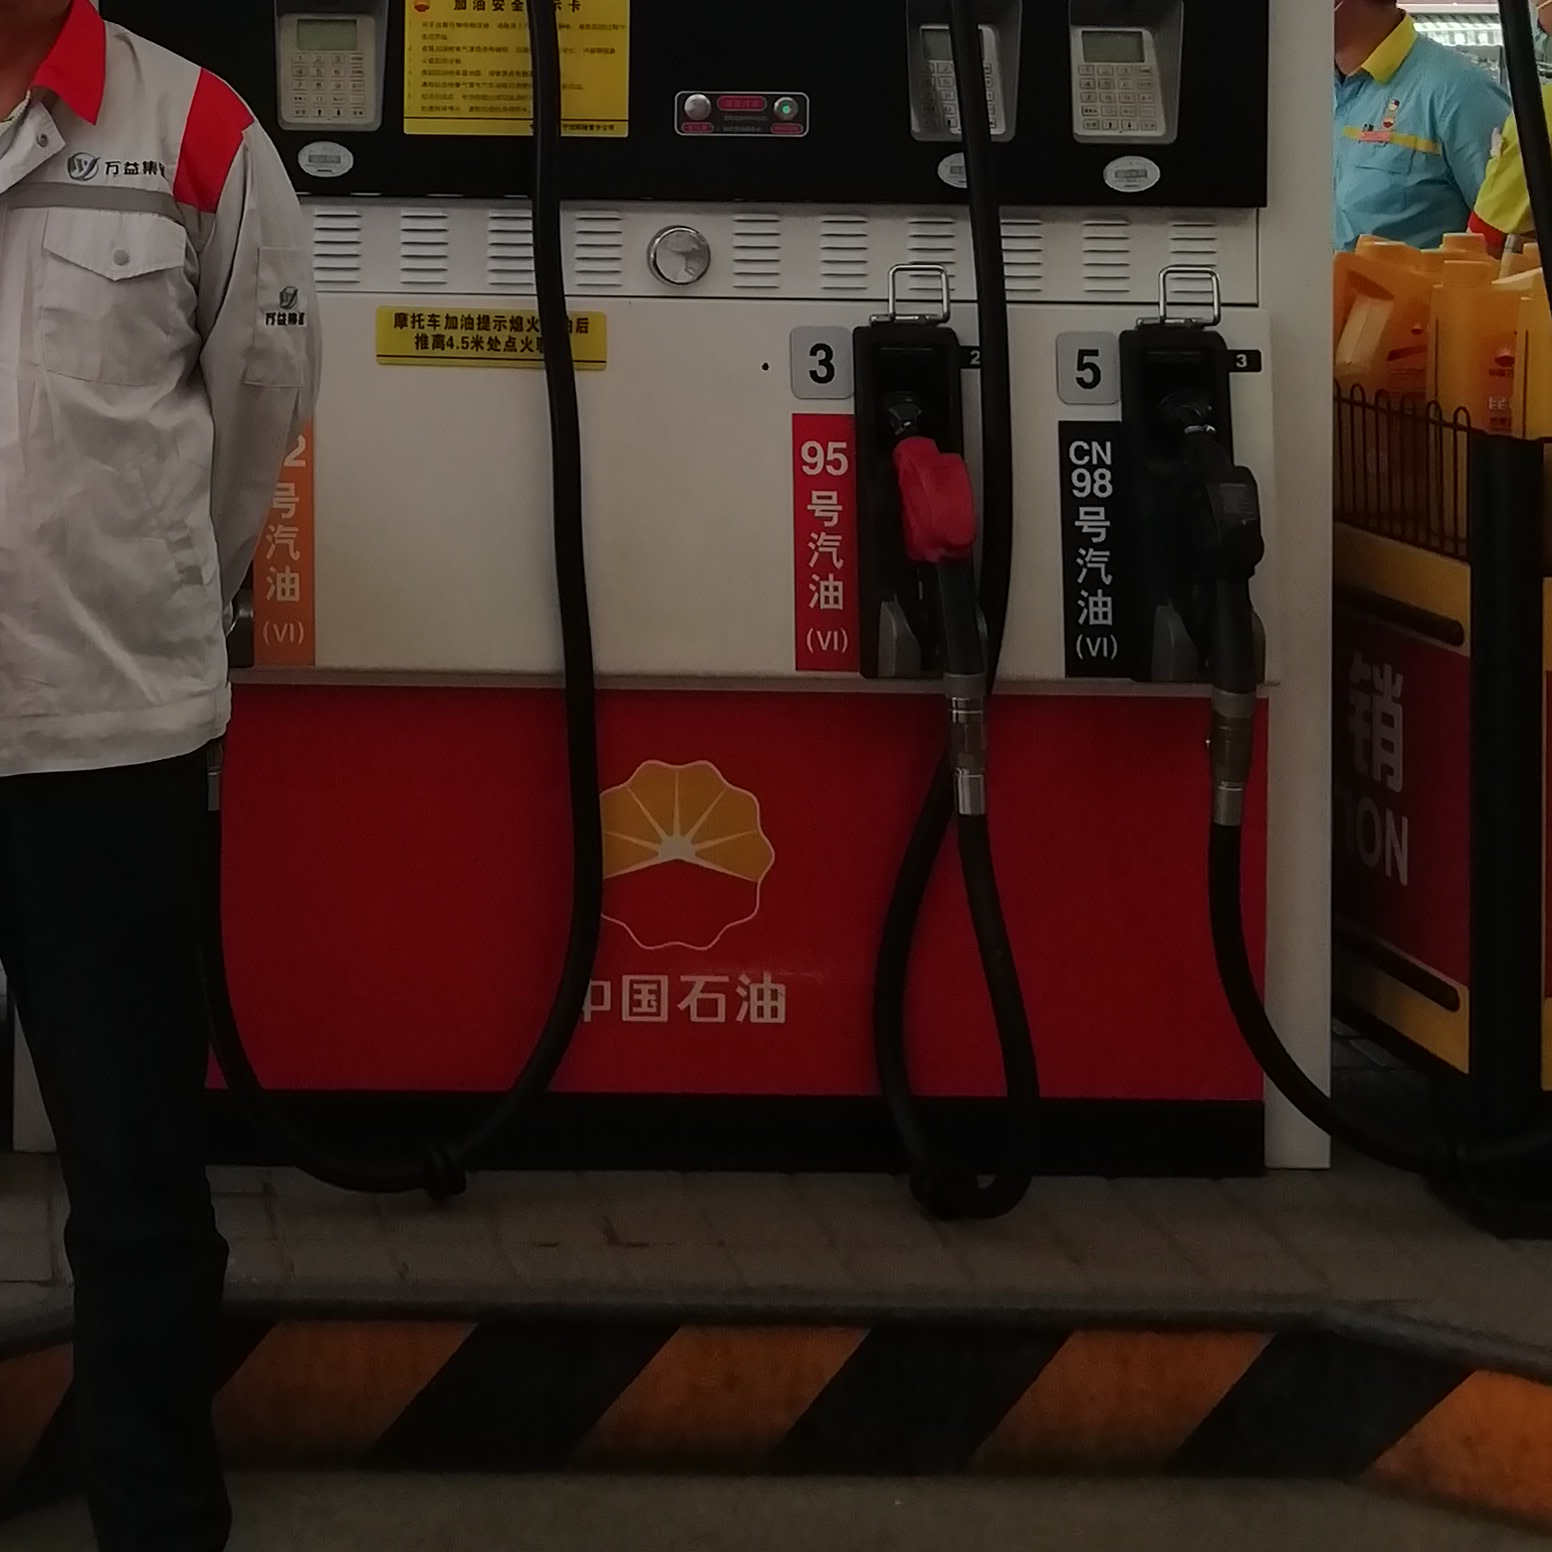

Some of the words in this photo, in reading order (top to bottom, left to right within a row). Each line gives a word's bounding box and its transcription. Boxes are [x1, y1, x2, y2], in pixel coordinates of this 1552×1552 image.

[808, 343, 836, 385] 3
[1075, 349, 1102, 390] 5
[581, 970, 787, 1024] 中国石油
